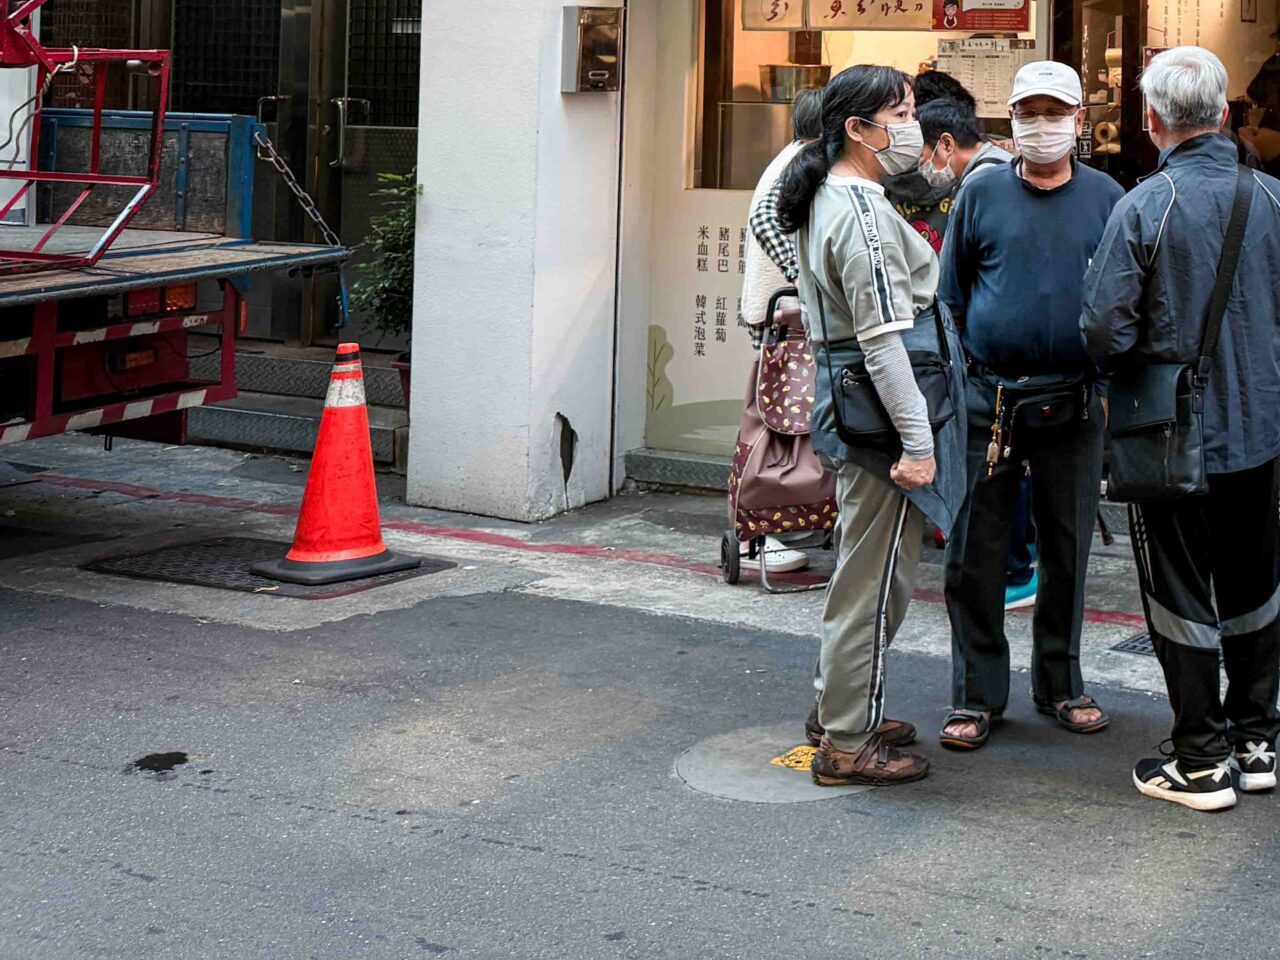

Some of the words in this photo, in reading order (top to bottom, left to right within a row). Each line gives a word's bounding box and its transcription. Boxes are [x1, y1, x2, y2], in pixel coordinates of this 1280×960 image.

[696, 225, 709, 272] 米血糕
[717, 226, 730, 273] 豬尾巴
[694, 294, 706, 357] 韓式泡菜
[715, 296, 727, 342] 紅蘿蔔
